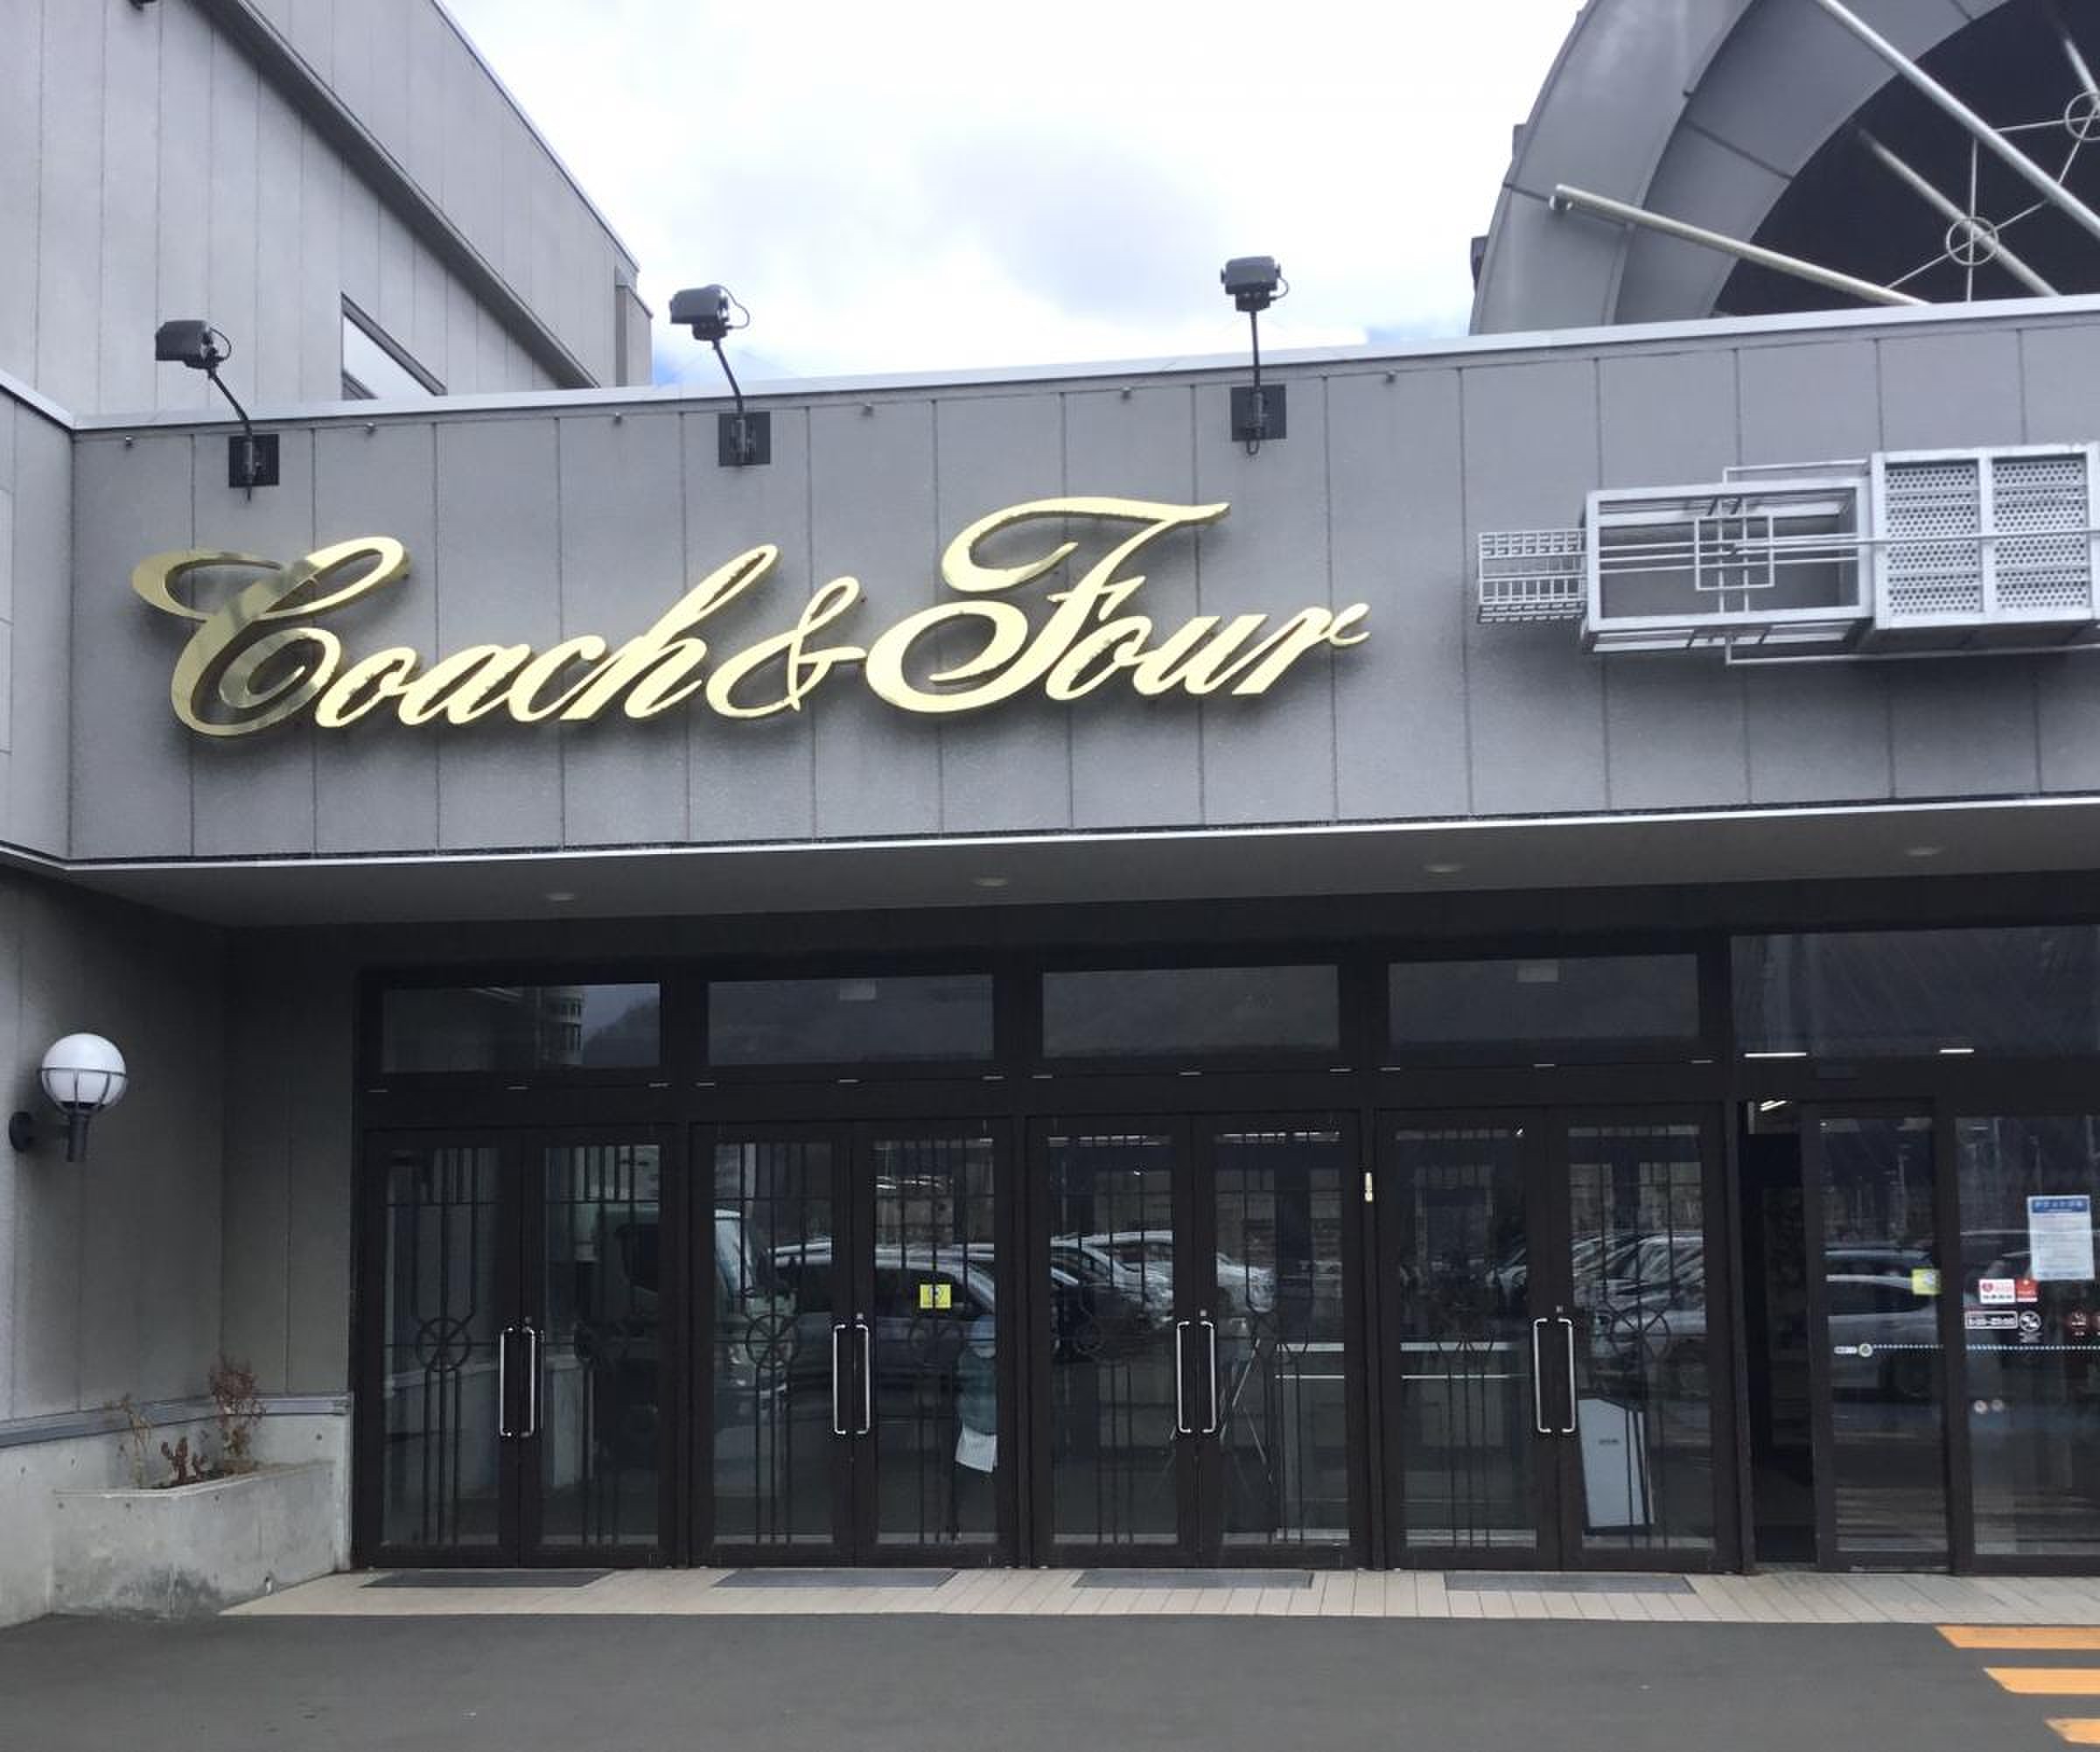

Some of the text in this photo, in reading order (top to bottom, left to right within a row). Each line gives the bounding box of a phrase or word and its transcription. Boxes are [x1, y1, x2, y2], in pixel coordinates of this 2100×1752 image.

[132, 496, 1370, 737] Coach & Four
